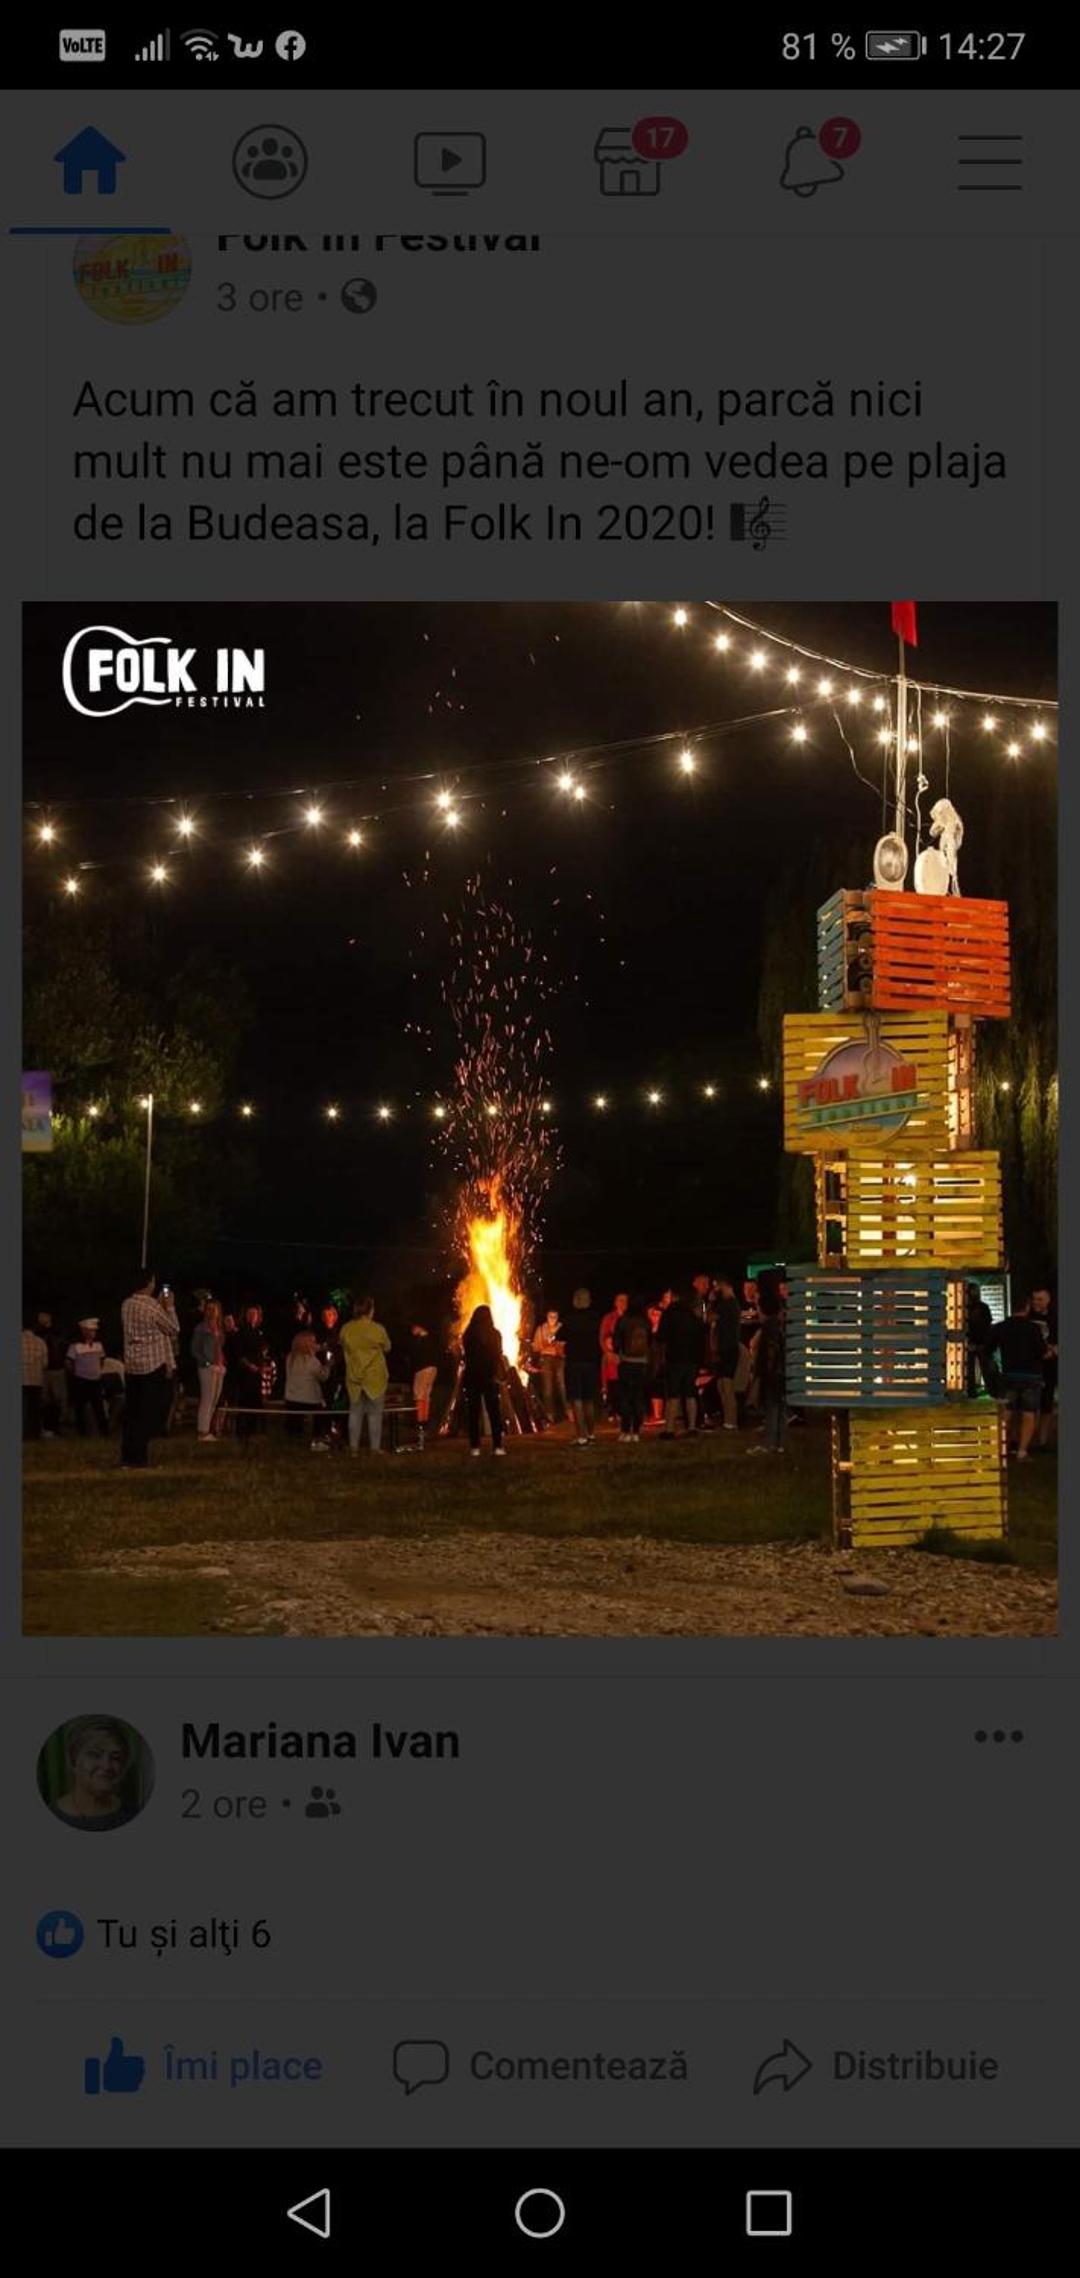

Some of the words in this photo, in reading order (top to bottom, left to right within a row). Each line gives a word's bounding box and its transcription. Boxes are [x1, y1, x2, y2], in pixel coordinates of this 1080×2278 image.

[63, 37, 104, 53] VoLTE
[782, 32, 815, 60] 81
[831, 32, 856, 60] %
[939, 32, 1026, 60] 14:27
[648, 127, 675, 149] 17
[834, 127, 848, 149] 7
[217, 282, 237, 312] 3
[249, 289, 303, 312] ore
[73, 380, 194, 417] Acum
[210, 379, 257, 417] că
[272, 389, 336, 417] am
[350, 383, 473, 417] trecut
[487, 379, 524, 417] în
[541, 379, 627, 417] noul
[643, 389, 703, 423] an,
[718, 379, 834, 426] parcă
[850, 380, 922, 417] nici
[74, 440, 167, 479] mult
[183, 451, 231, 479] nu
[247, 442, 322, 479] mai
[338, 445, 428, 479] este
[442, 441, 544, 489] până
[561, 450, 690, 479] ne-om
[704, 440, 828, 479] vedea
[844, 451, 894, 489] pe
[908, 440, 1006, 489] plaja
[74, 502, 124, 541] de
[138, 502, 172, 541] la
[188, 502, 380, 547] Budeasa,
[395, 502, 428, 541] la
[444, 502, 532, 541] Folk
[547, 504, 582, 541] In
[597, 504, 714, 541] 2020!
[182, 1721, 357, 1759] Mariana
[372, 1722, 460, 1759] Ivan
[181, 1788, 201, 1818] 2
[213, 1796, 267, 1818] ore
[97, 1919, 137, 1948] Tu
[252, 1919, 272, 1949] 6
[162, 2043, 218, 2080] Îmi
[230, 2049, 323, 2088] place
[470, 2050, 688, 2081] Comentează
[834, 2049, 999, 2081] Distribuie
